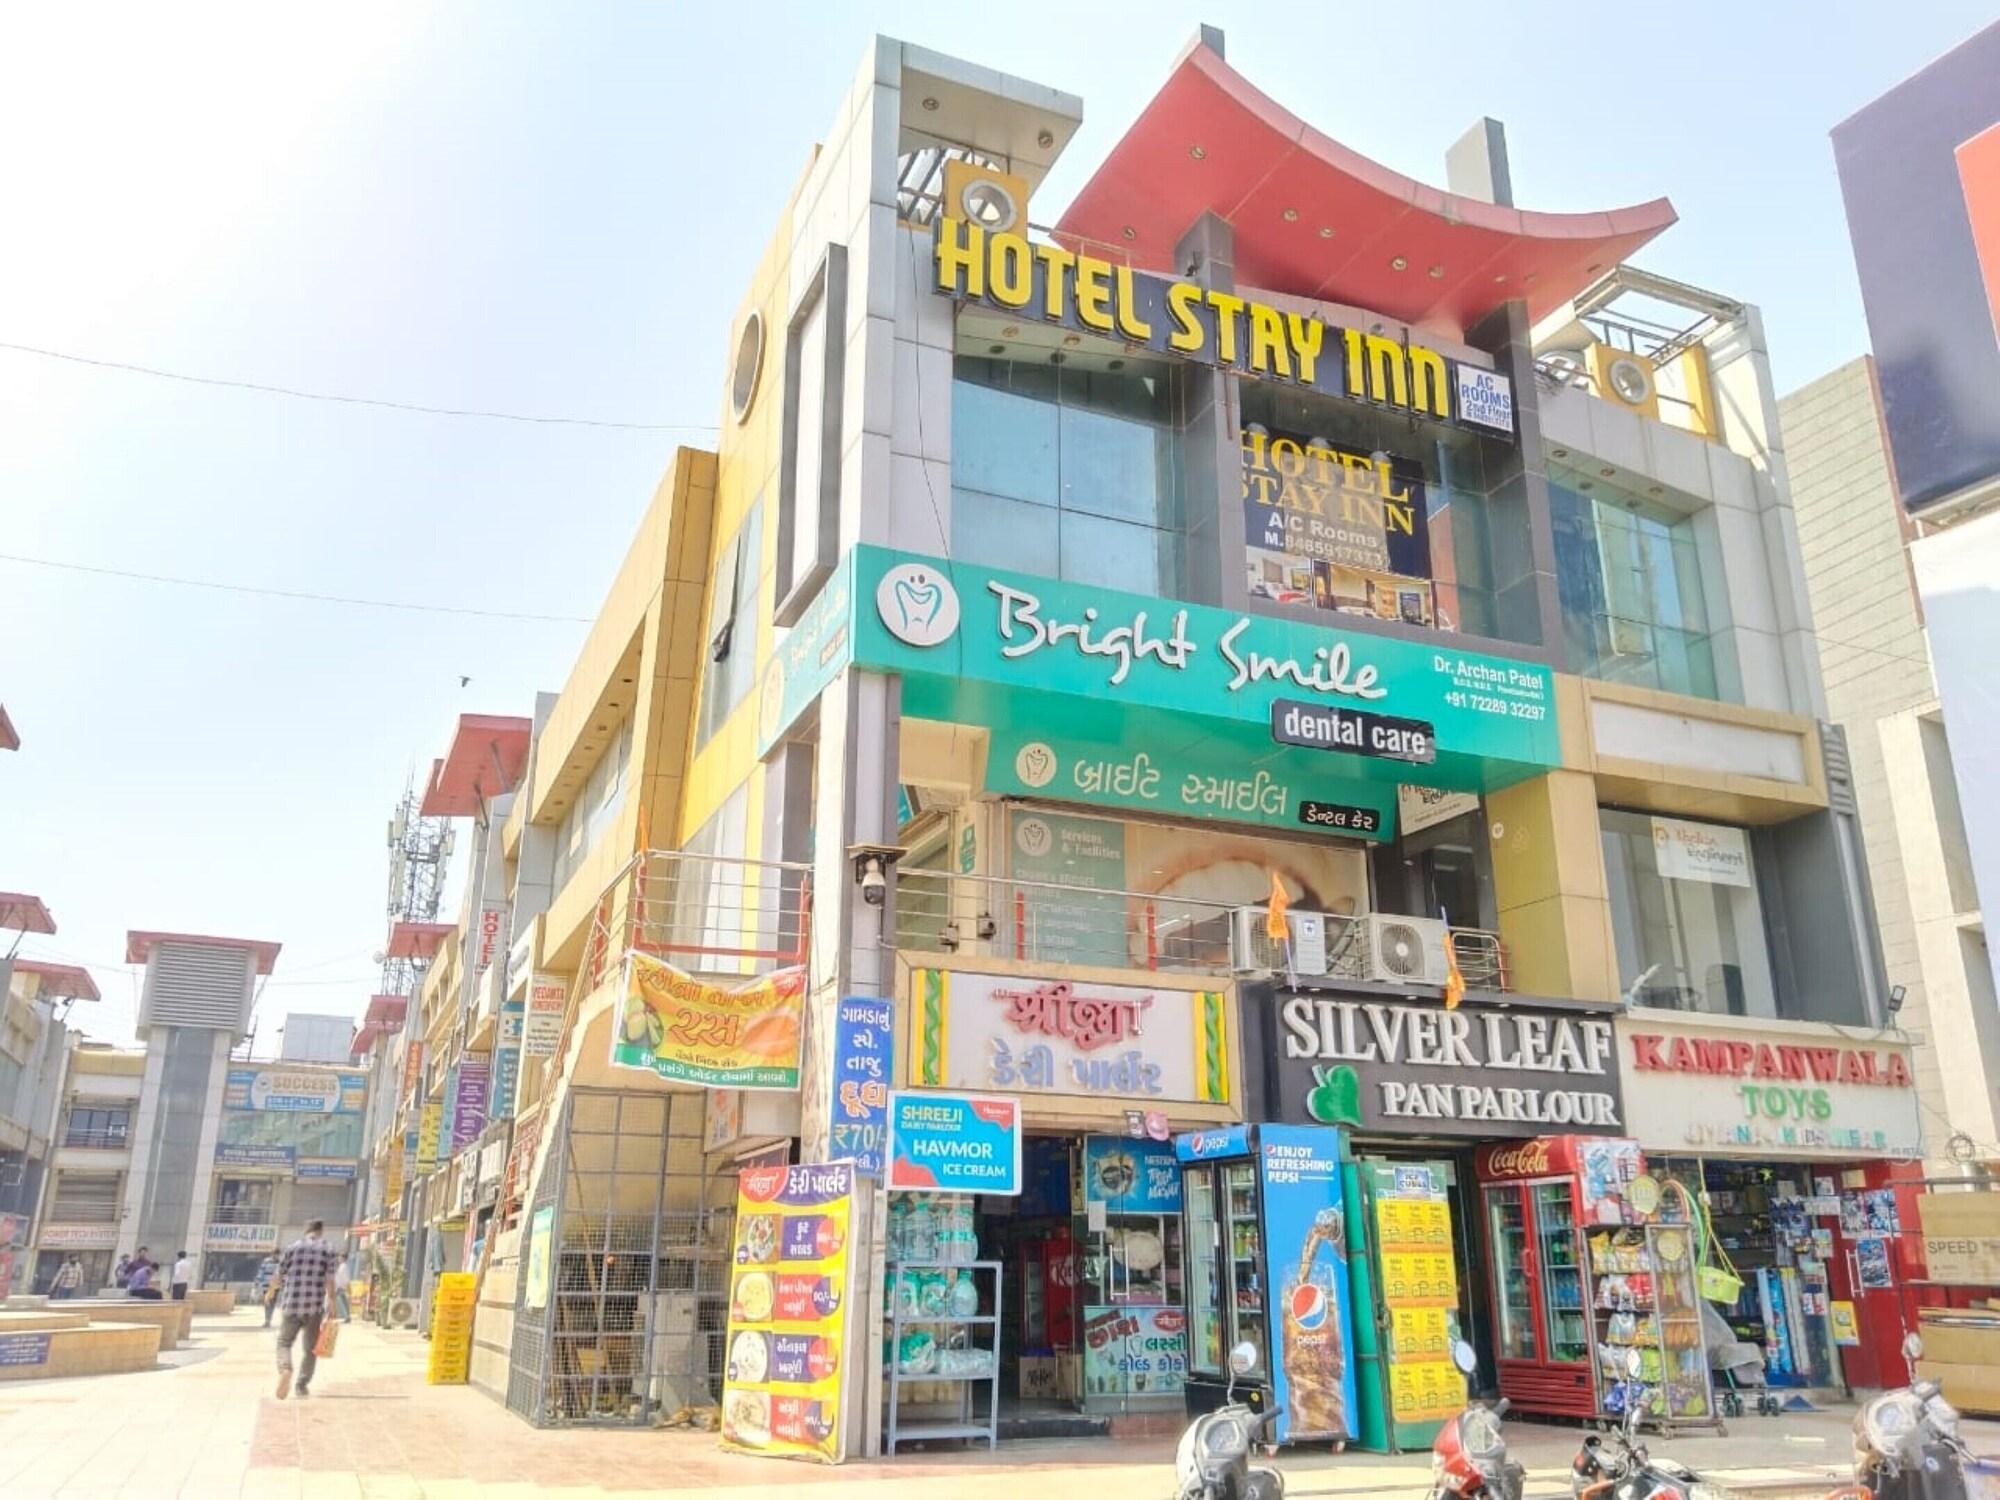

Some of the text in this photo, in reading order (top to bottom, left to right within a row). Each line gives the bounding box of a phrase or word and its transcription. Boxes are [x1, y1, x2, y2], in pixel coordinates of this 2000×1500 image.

[936, 217, 1449, 418] HOTEL STAY INN
[1461, 384, 1510, 409] ROOMS
[1476, 374, 1494, 390] AC
[1240, 430, 1408, 503] HOTEL
[1268, 512, 1377, 548] A/C Rooms
[1340, 494, 1414, 536] INN
[987, 580, 1389, 699] Bright Smile
[1434, 655, 1453, 673] Dr.
[1457, 660, 1506, 683] Archan
[1508, 669, 1544, 690] Patel
[1445, 691, 1467, 708] +91
[1284, 708, 1427, 756] dental care
[1181, 770, 1289, 816] સ્માઈલ
[1351, 806, 1375, 831] કેર
[481, 911, 499, 965] HOTEL
[1283, 996, 1613, 1075] SILVER LEAF
[990, 1038, 1164, 1094] ડેરી પાર્લર
[1631, 1033, 1912, 1089] KAMPANWALA
[271, 1076, 336, 1090] SUCCESS
[839, 1080, 887, 1119] દૂધ
[901, 1105, 963, 1122] SHREEJI
[1379, 1080, 1622, 1127] PAN PARLOUR
[1738, 1084, 1833, 1121] TOYS
[912, 1139, 993, 1159] HAVMOR
[1204, 1135, 1230, 1153] pepsi
[1277, 1146, 1313, 1158] ENJOY
[943, 1163, 1006, 1177] ICE CREAM
[1266, 1158, 1335, 1172] REFRESHING
[1268, 1171, 1300, 1183] PEPSI
[788, 1169, 809, 1195] ડેરી
[1928, 1239, 1979, 1254] SPEED
[1145, 1332, 1187, 1351] લસ્સી
